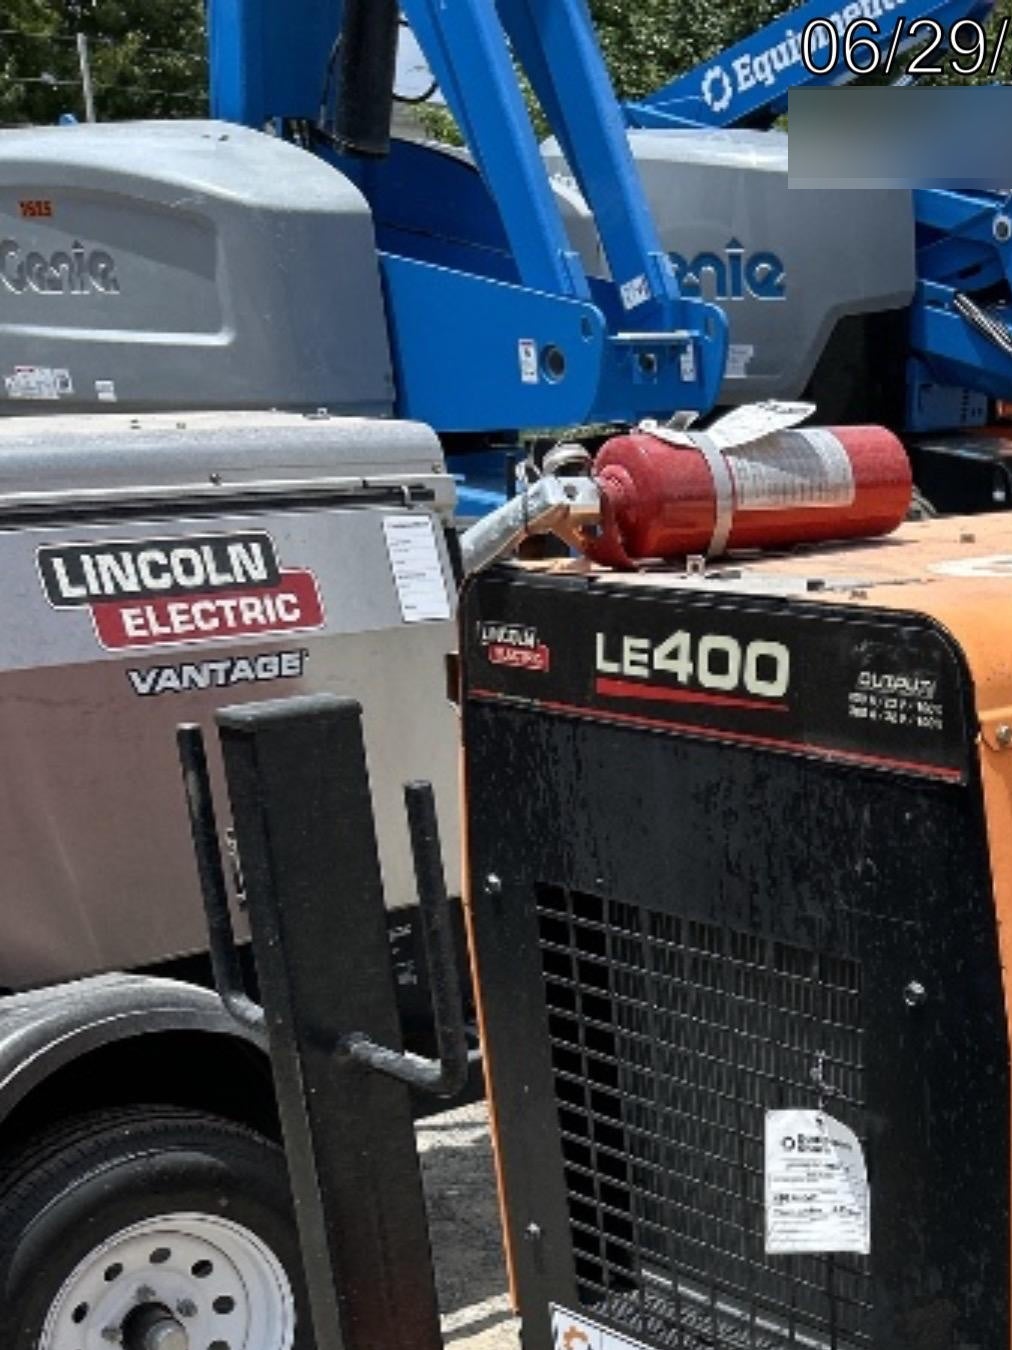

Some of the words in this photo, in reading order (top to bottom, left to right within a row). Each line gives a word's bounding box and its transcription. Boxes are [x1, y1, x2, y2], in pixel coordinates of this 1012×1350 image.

[0, 239, 120, 294] Genie
[667, 237, 787, 300] enie
[52, 542, 268, 598] LINCOLN
[120, 593, 300, 638] ELECTRIC
[127, 650, 304, 697] VANTAGE
[596, 629, 790, 697] LE400
